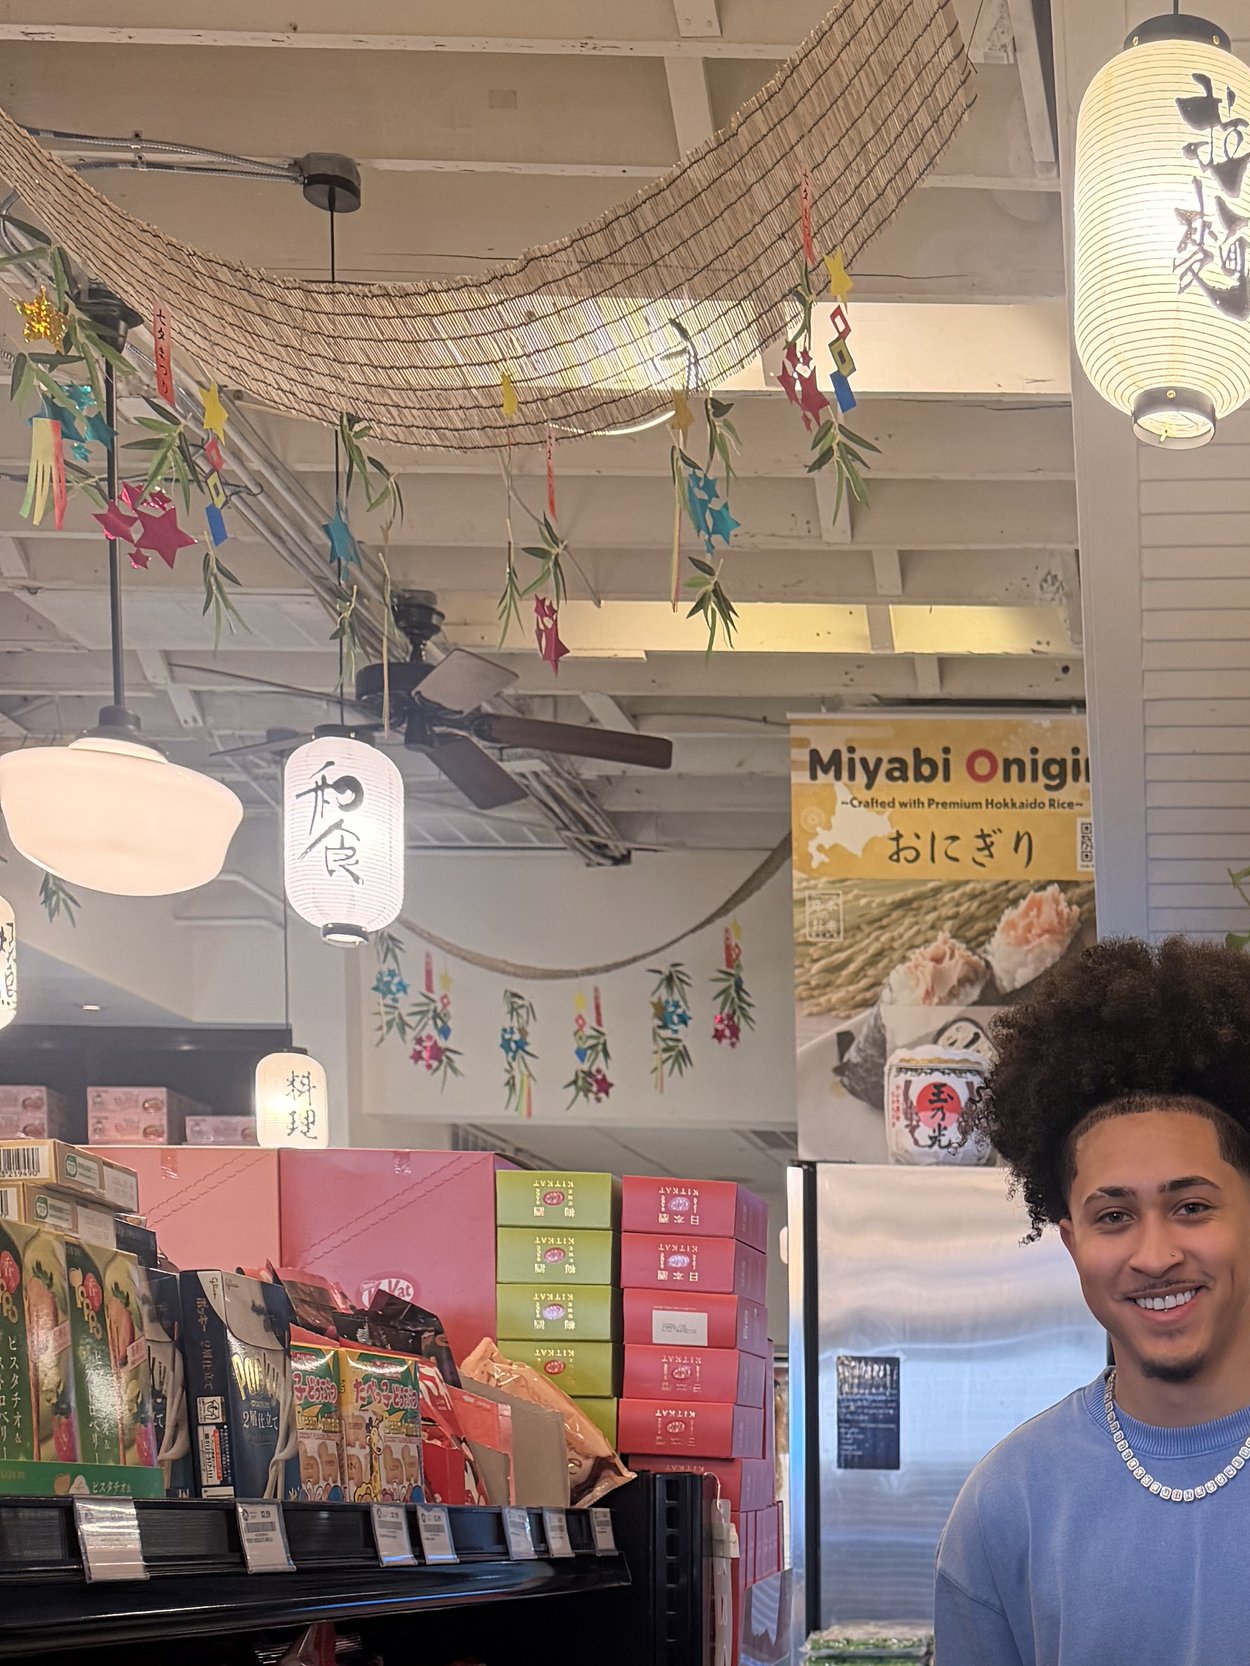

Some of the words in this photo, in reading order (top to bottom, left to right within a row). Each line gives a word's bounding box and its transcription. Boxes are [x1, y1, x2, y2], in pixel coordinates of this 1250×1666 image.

[808, 746, 951, 791] Miyabi
[965, 746, 1090, 791] Onigi
[295, 761, 364, 885] 和食
[899, 798, 925, 809] with
[928, 798, 983, 810] Premium
[985, 798, 1046, 811] Hokkaido
[888, 827, 1034, 868] おにぎり
[285, 1070, 318, 1140] 料理
